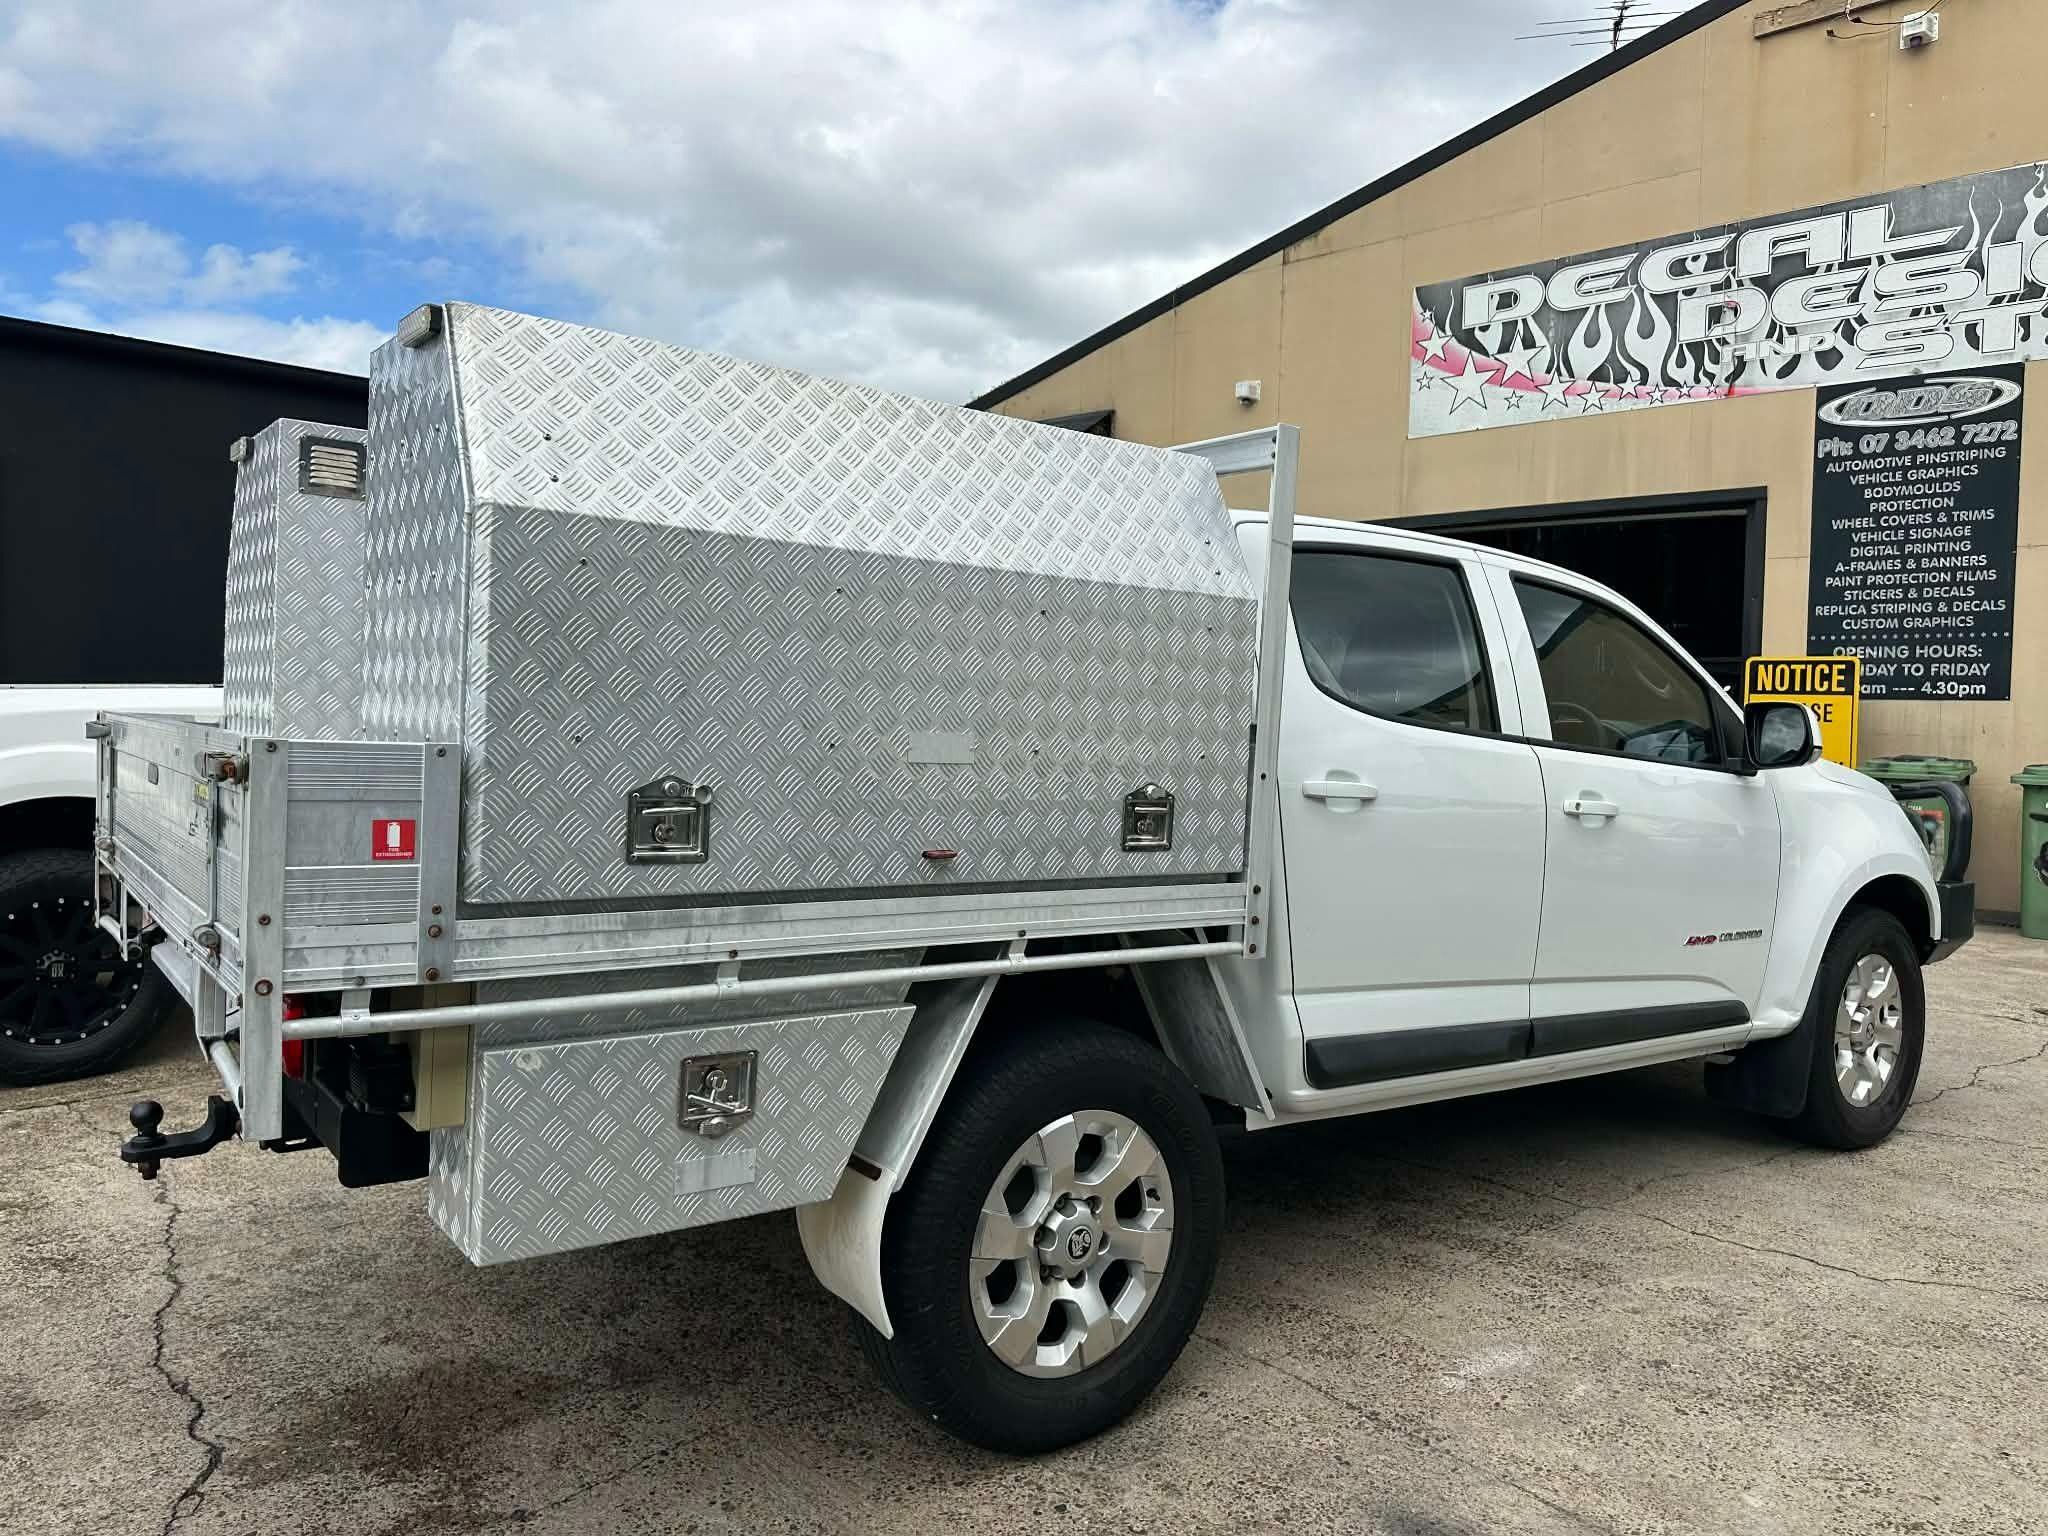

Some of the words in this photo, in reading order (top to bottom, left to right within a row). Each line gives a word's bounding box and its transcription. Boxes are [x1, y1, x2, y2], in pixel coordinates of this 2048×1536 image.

[1462, 203, 1964, 330] DECAL
[1721, 330, 1836, 363] AND
[1859, 433, 1889, 454] 07
[1894, 426, 1955, 450] 3462
[1961, 420, 2018, 445] 7272
[1826, 455, 1911, 473] AUTOMOTIVE
[1916, 447, 2007, 464] PINSTRIPING
[1850, 470, 1903, 485] VEHICLE
[1907, 464, 1979, 480] GRAPHICS
[1864, 481, 1961, 498] BODYMOULDS
[1869, 497, 1954, 513] PROTECTION
[1831, 517, 1876, 530] WHEEL
[1880, 512, 1933, 527] COVERS
[1936, 511, 1948, 523] &
[1952, 508, 1995, 522] TRIMS
[1852, 529, 1905, 543] VEHICLE
[1909, 525, 1972, 540] SIGNAGE
[1850, 545, 1901, 558] DIGITAL
[1904, 540, 1972, 555] PRINTING
[1835, 559, 1902, 573] A-FRAMES
[1906, 558, 1917, 569] &
[1921, 554, 1988, 569] BANNERS
[1825, 575, 1863, 588] PAINT
[1866, 571, 1951, 586] PROTECTION
[1956, 569, 1997, 582] FILMS
[1844, 588, 1904, 601] STICKERS
[1907, 587, 1918, 599] &
[1923, 585, 1975, 598] DECALS
[1815, 604, 1867, 617] REPLICA
[1871, 602, 1933, 615] STRIPING
[1937, 601, 1948, 613] &
[1952, 599, 2007, 612] DECALS
[1842, 617, 1899, 630] CUSTOM
[1903, 615, 1975, 629] GRAPHICS
[1833, 645, 1909, 659] OPENING
[1915, 644, 1983, 658] HOURS:
[1757, 663, 1846, 692] NOTICE
[1902, 663, 1924, 676] TO
[1930, 663, 1991, 676] FRIDAY
[1920, 681, 1987, 698] 4.30pm
